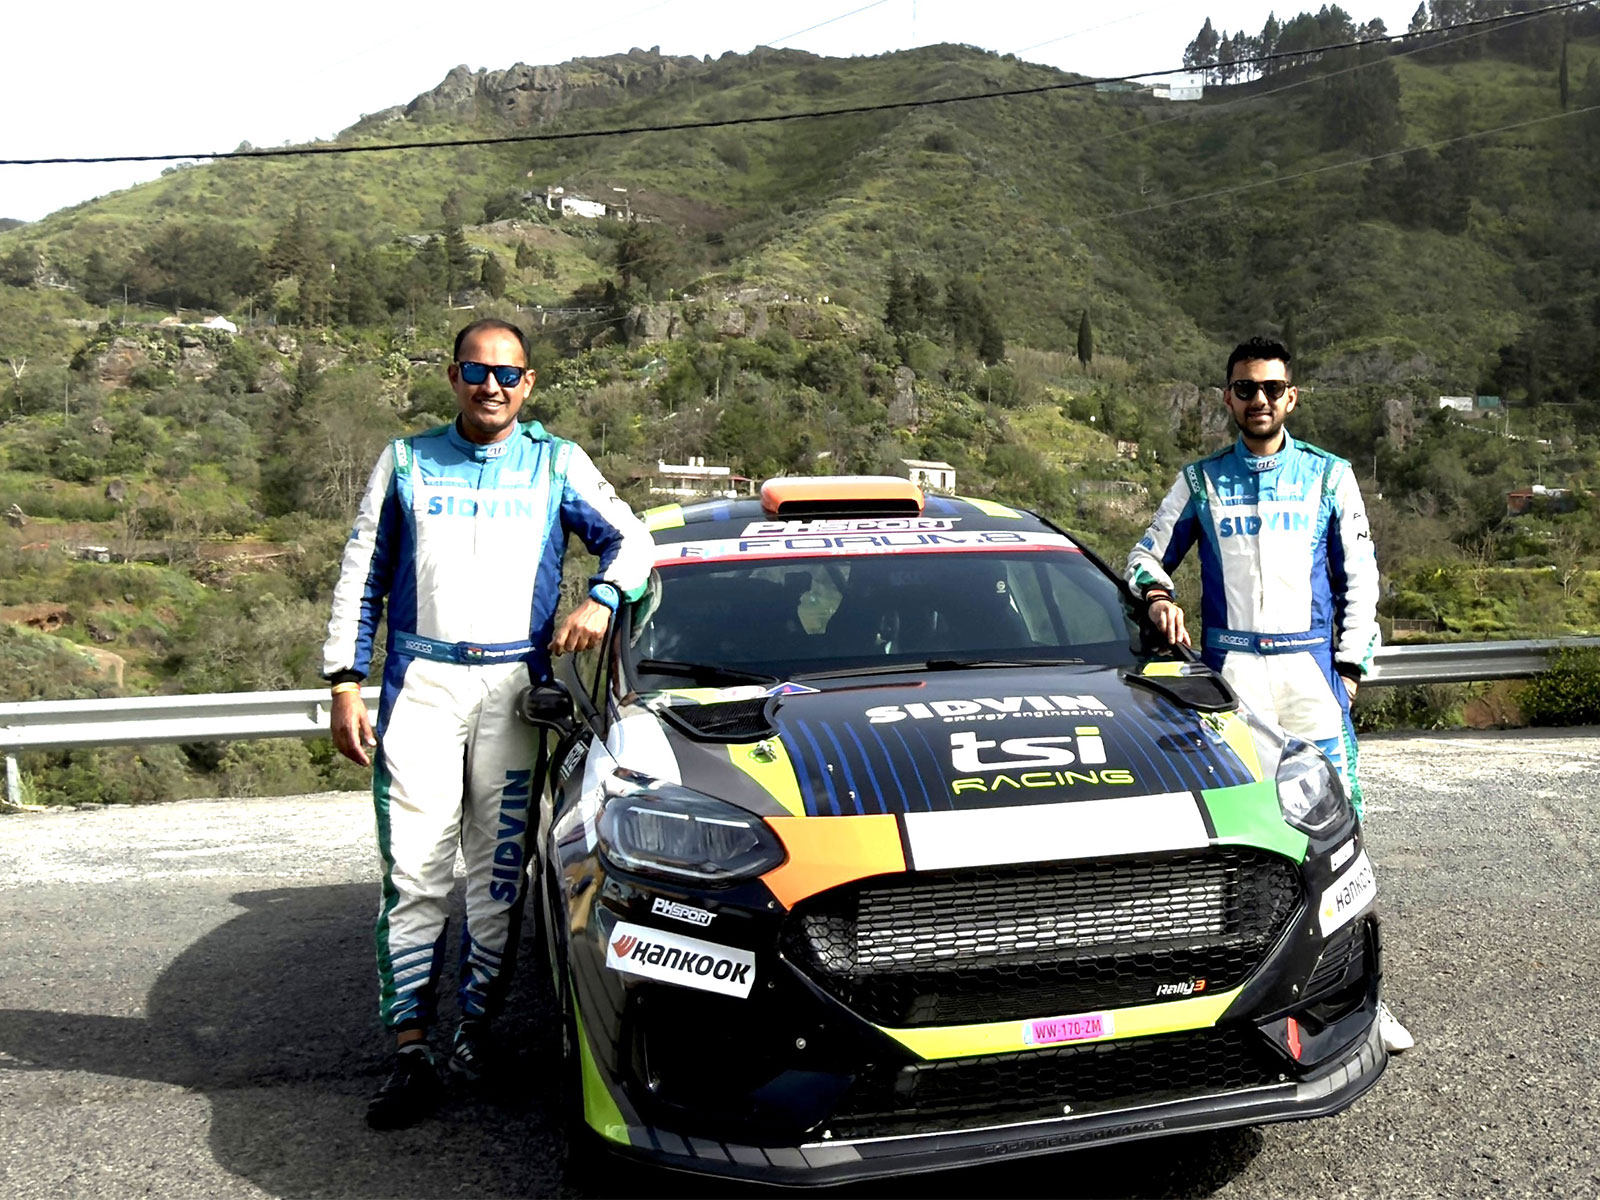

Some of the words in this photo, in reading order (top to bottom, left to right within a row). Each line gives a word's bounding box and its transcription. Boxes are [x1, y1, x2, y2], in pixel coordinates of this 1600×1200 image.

[428, 496, 533, 518] SIDVIN
[1219, 512, 1310, 538] SIDVIN
[865, 695, 1109, 724] SIDVIN
[943, 712, 1007, 724] energy
[1012, 707, 1115, 719] engineering
[950, 726, 1108, 773] tsi
[951, 769, 1135, 795] RACING
[489, 769, 532, 906] SIDVIN
[651, 897, 718, 928] PHSPORT
[1156, 978, 1206, 997] Rally3
[1034, 1018, 1102, 1040] WW-170-ZM
